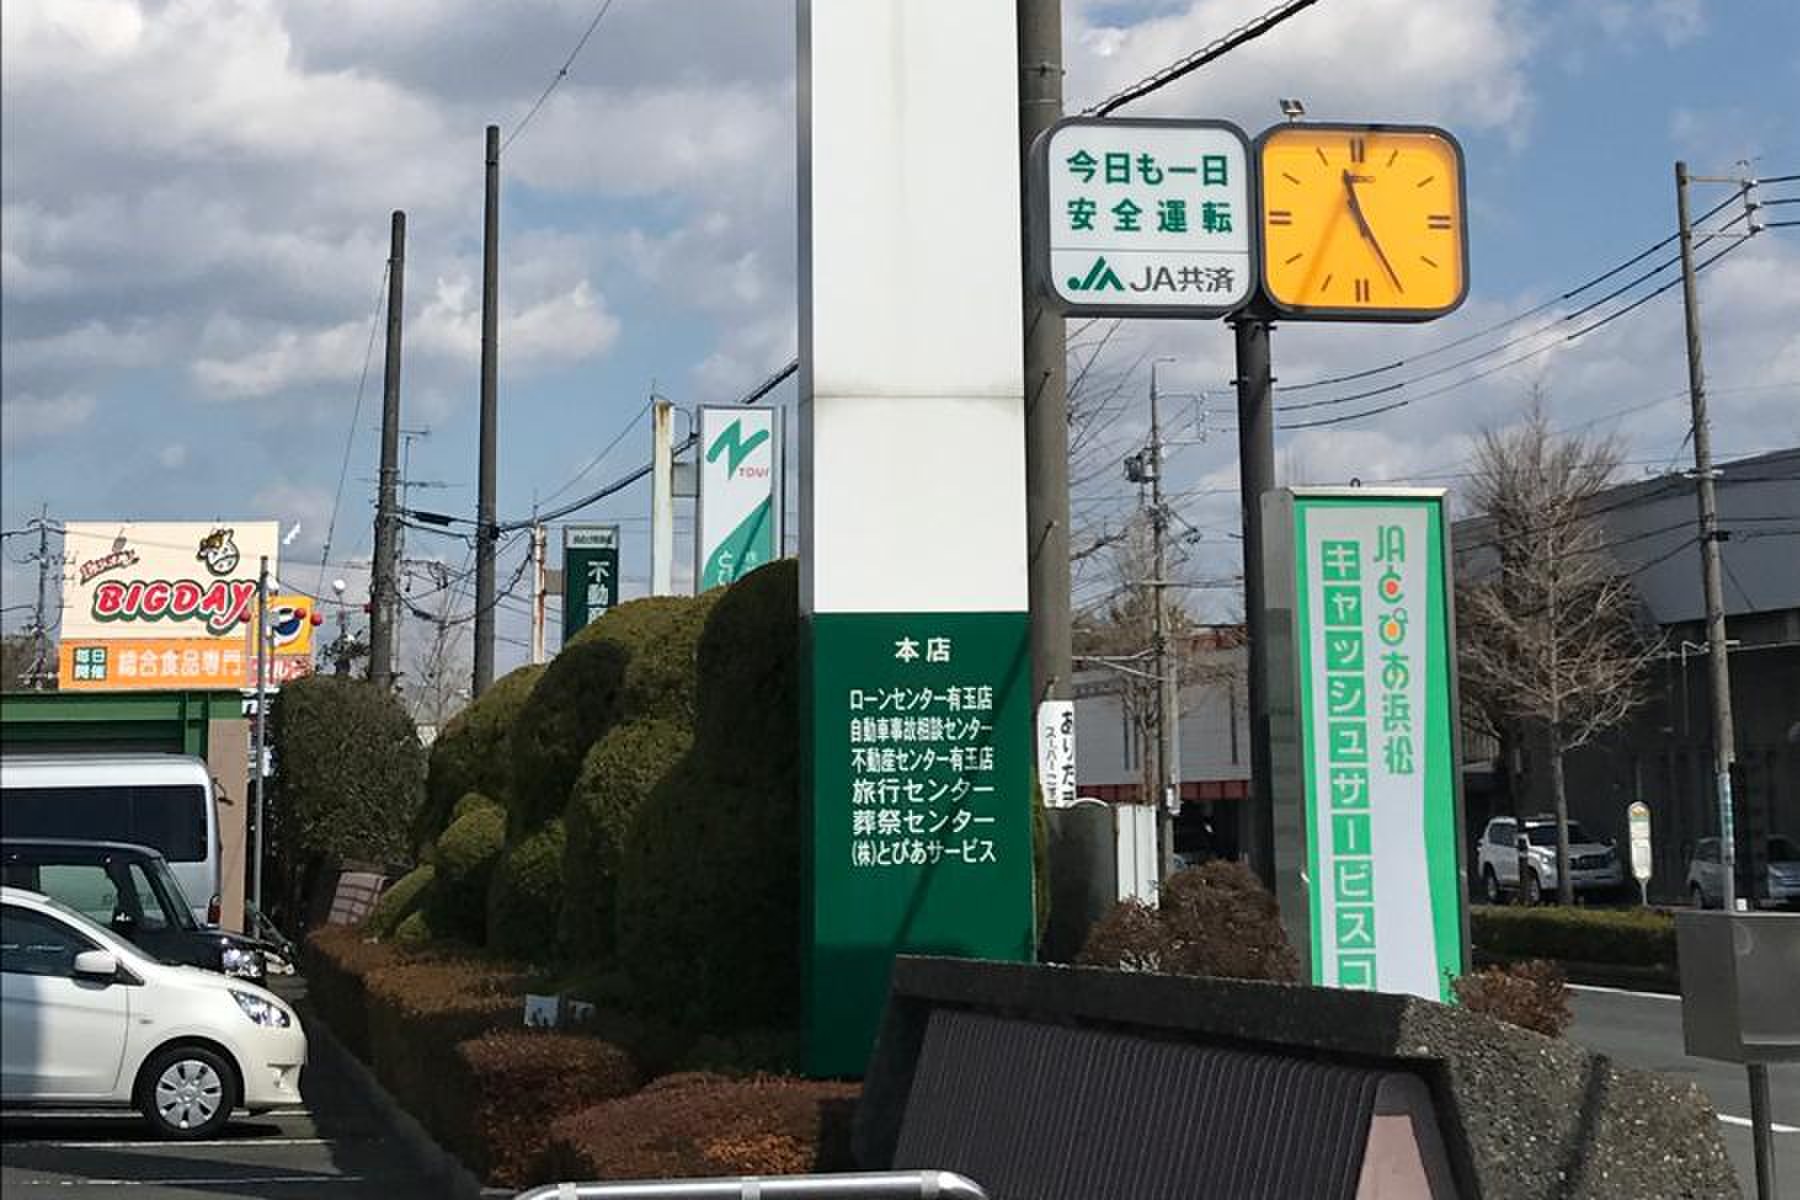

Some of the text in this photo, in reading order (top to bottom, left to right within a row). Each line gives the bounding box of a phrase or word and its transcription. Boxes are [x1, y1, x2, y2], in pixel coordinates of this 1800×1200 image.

[1066, 150, 1229, 186] 今日も一日
[1067, 199, 1233, 234] 安全運転
[1130, 266, 1235, 292] JA共済
[94, 580, 257, 635] BIGDAY
[894, 637, 951, 662] 本店
[850, 716, 993, 743] 自動車事故相談センター
[852, 778, 994, 804] 旅行センター
[853, 809, 995, 835] 葬祭センター
